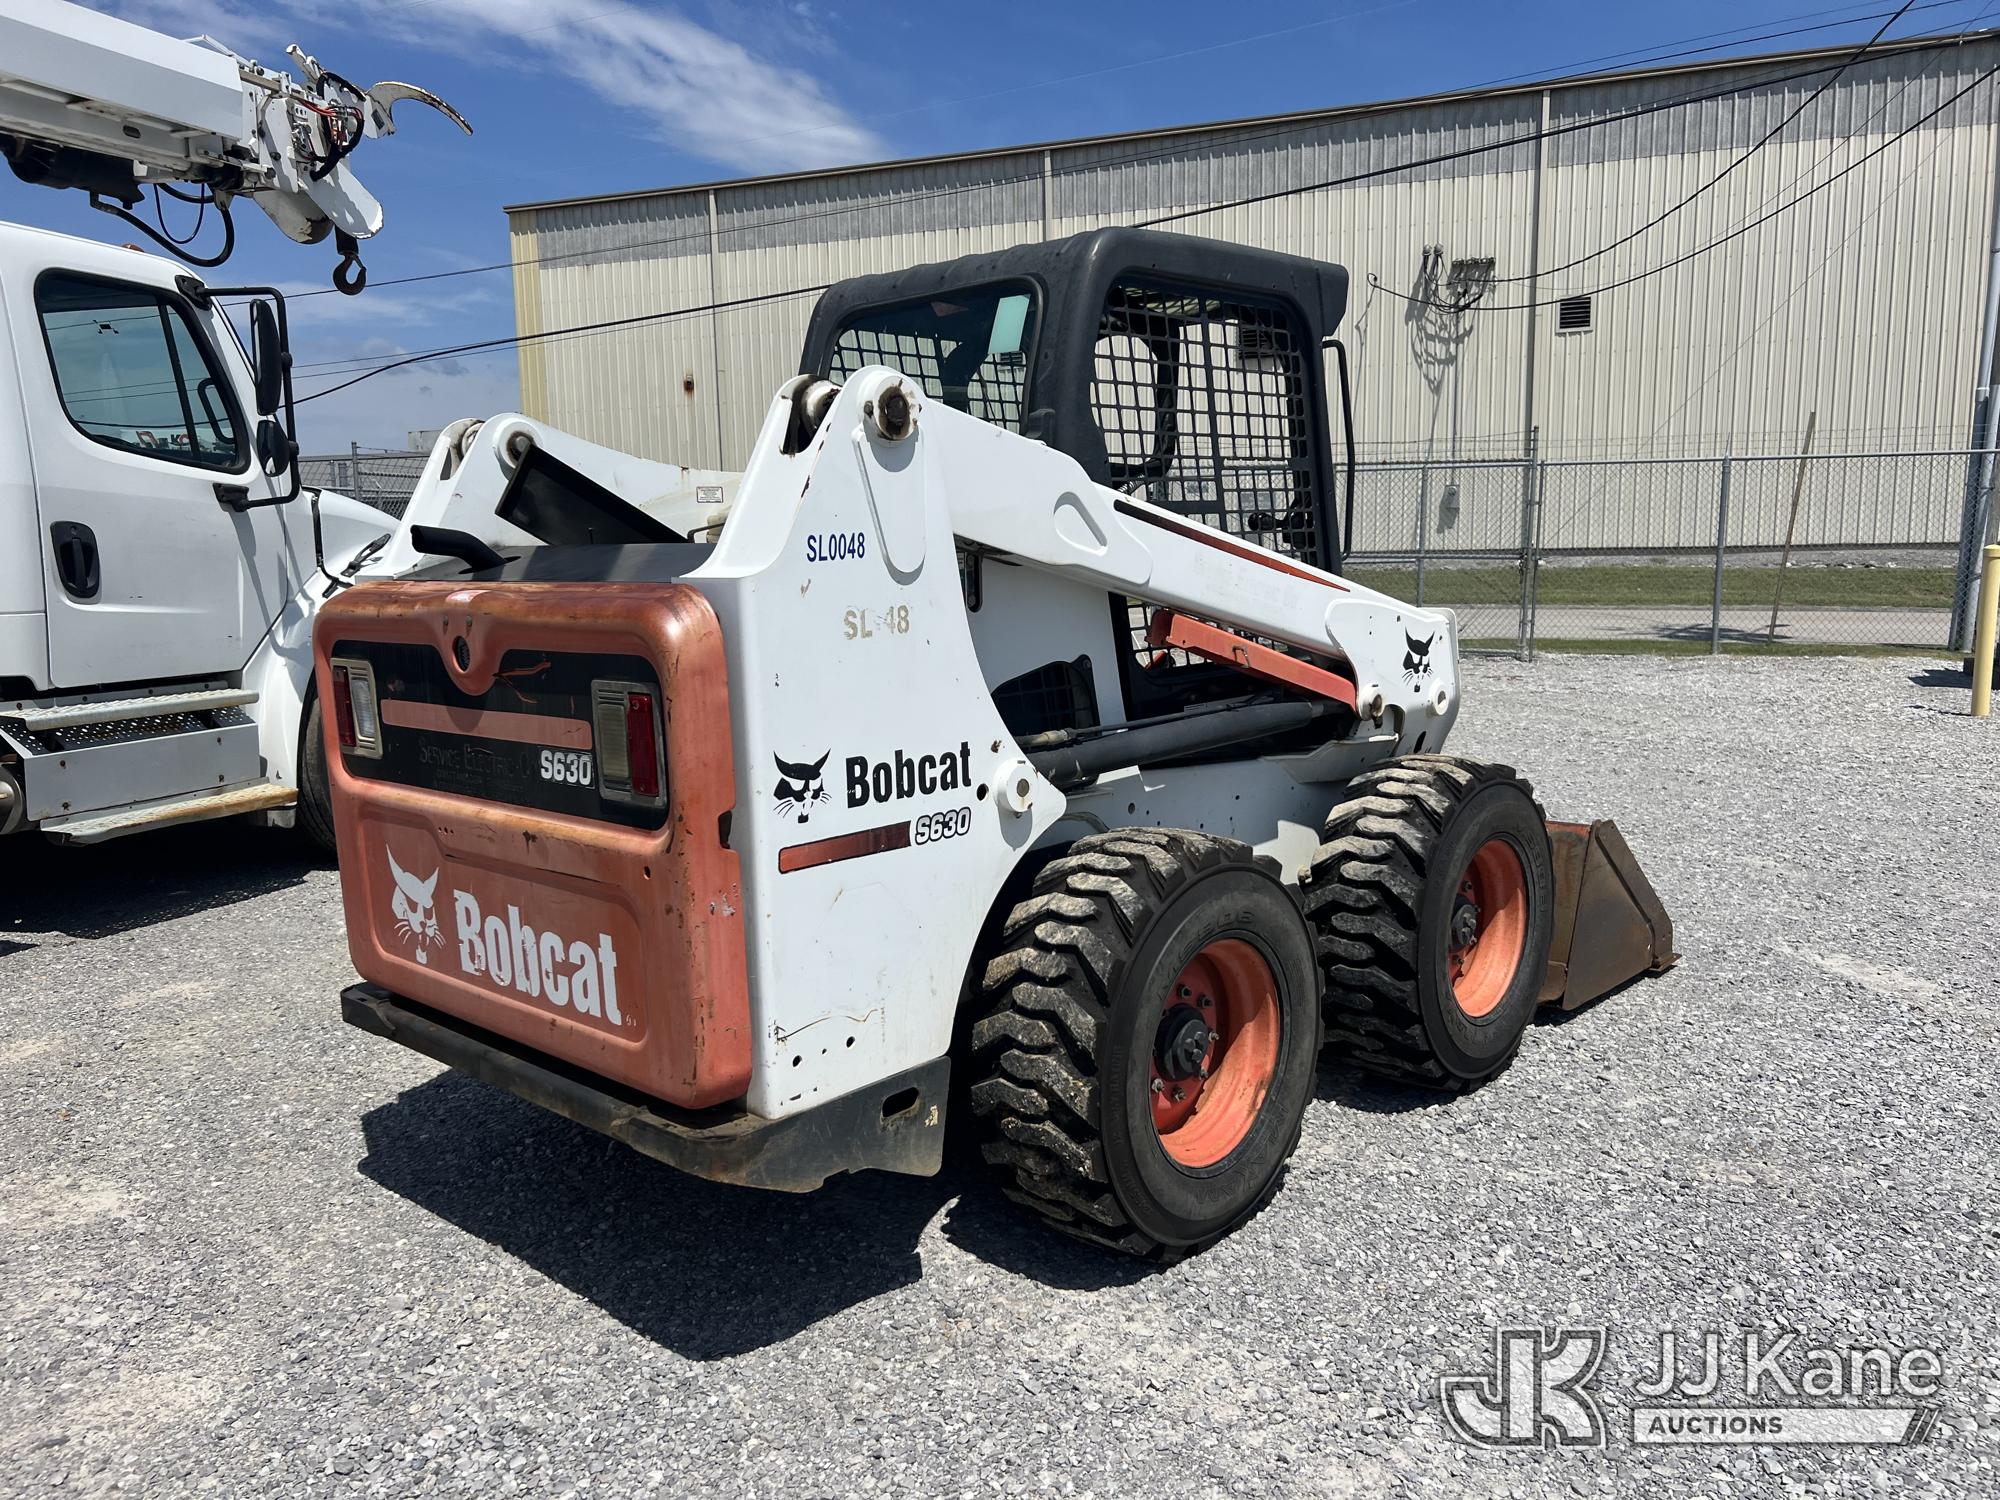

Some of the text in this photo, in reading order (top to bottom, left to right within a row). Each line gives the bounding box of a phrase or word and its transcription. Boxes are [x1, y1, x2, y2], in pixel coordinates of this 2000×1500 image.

[806, 532, 866, 563] SL0048
[540, 749, 593, 786] S630
[845, 741, 972, 809] Bobcat
[914, 806, 972, 846] S630
[453, 888, 623, 1026] Bobcat
